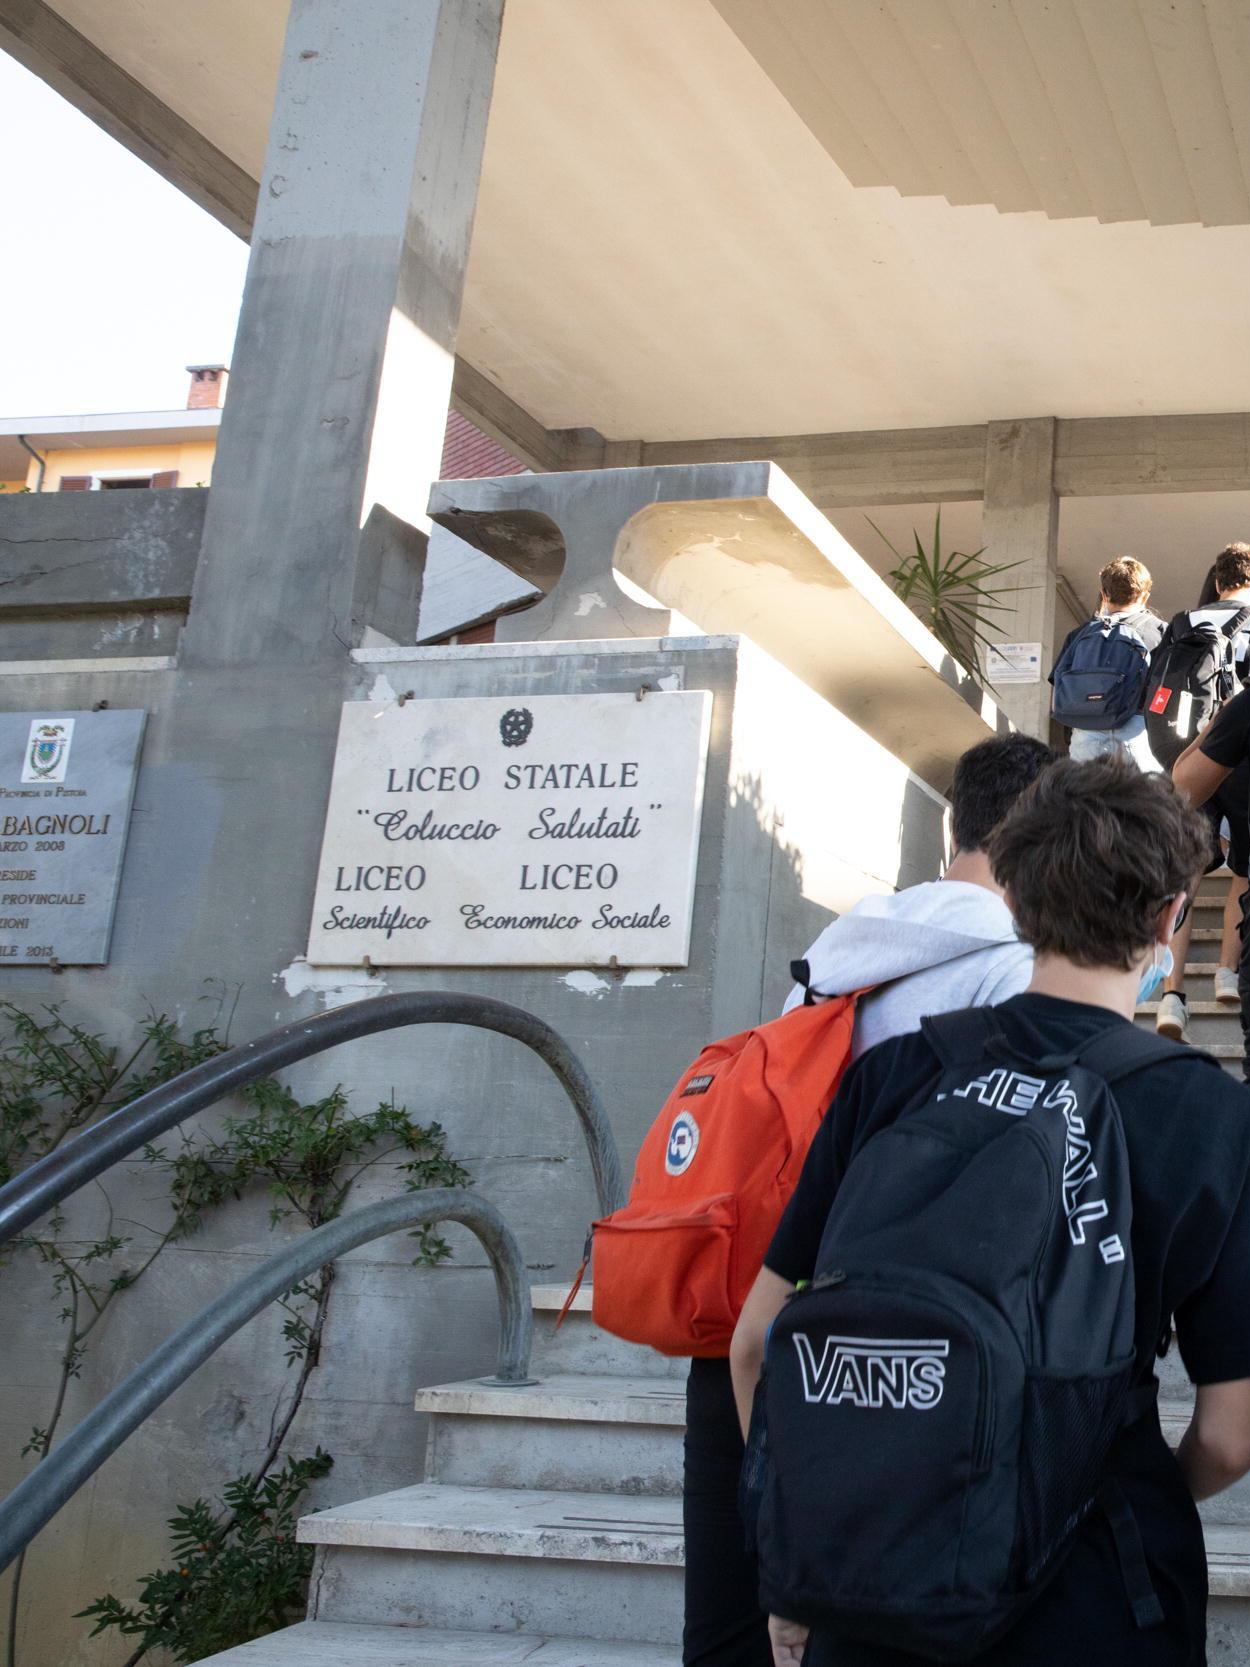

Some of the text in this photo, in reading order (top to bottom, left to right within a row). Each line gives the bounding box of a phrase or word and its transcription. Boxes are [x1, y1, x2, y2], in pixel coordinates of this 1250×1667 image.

[387, 761, 640, 793] LICEO STATALE
[0, 814, 111, 836] BAGNOLI
[0, 840, 66, 852] RZO 2008
[0, 869, 37, 881] ESIDE
[335, 865, 427, 891] LICEO
[519, 863, 619, 890] LICEO
[2, 893, 86, 905] PROVINCIALE
[0, 918, 29, 929] ZIONI
[322, 904, 431, 940] Scientifico
[459, 903, 672, 931] Economico Sociale
[0, 945, 18, 956] ILE
[793, 1332, 949, 1410] VANS
